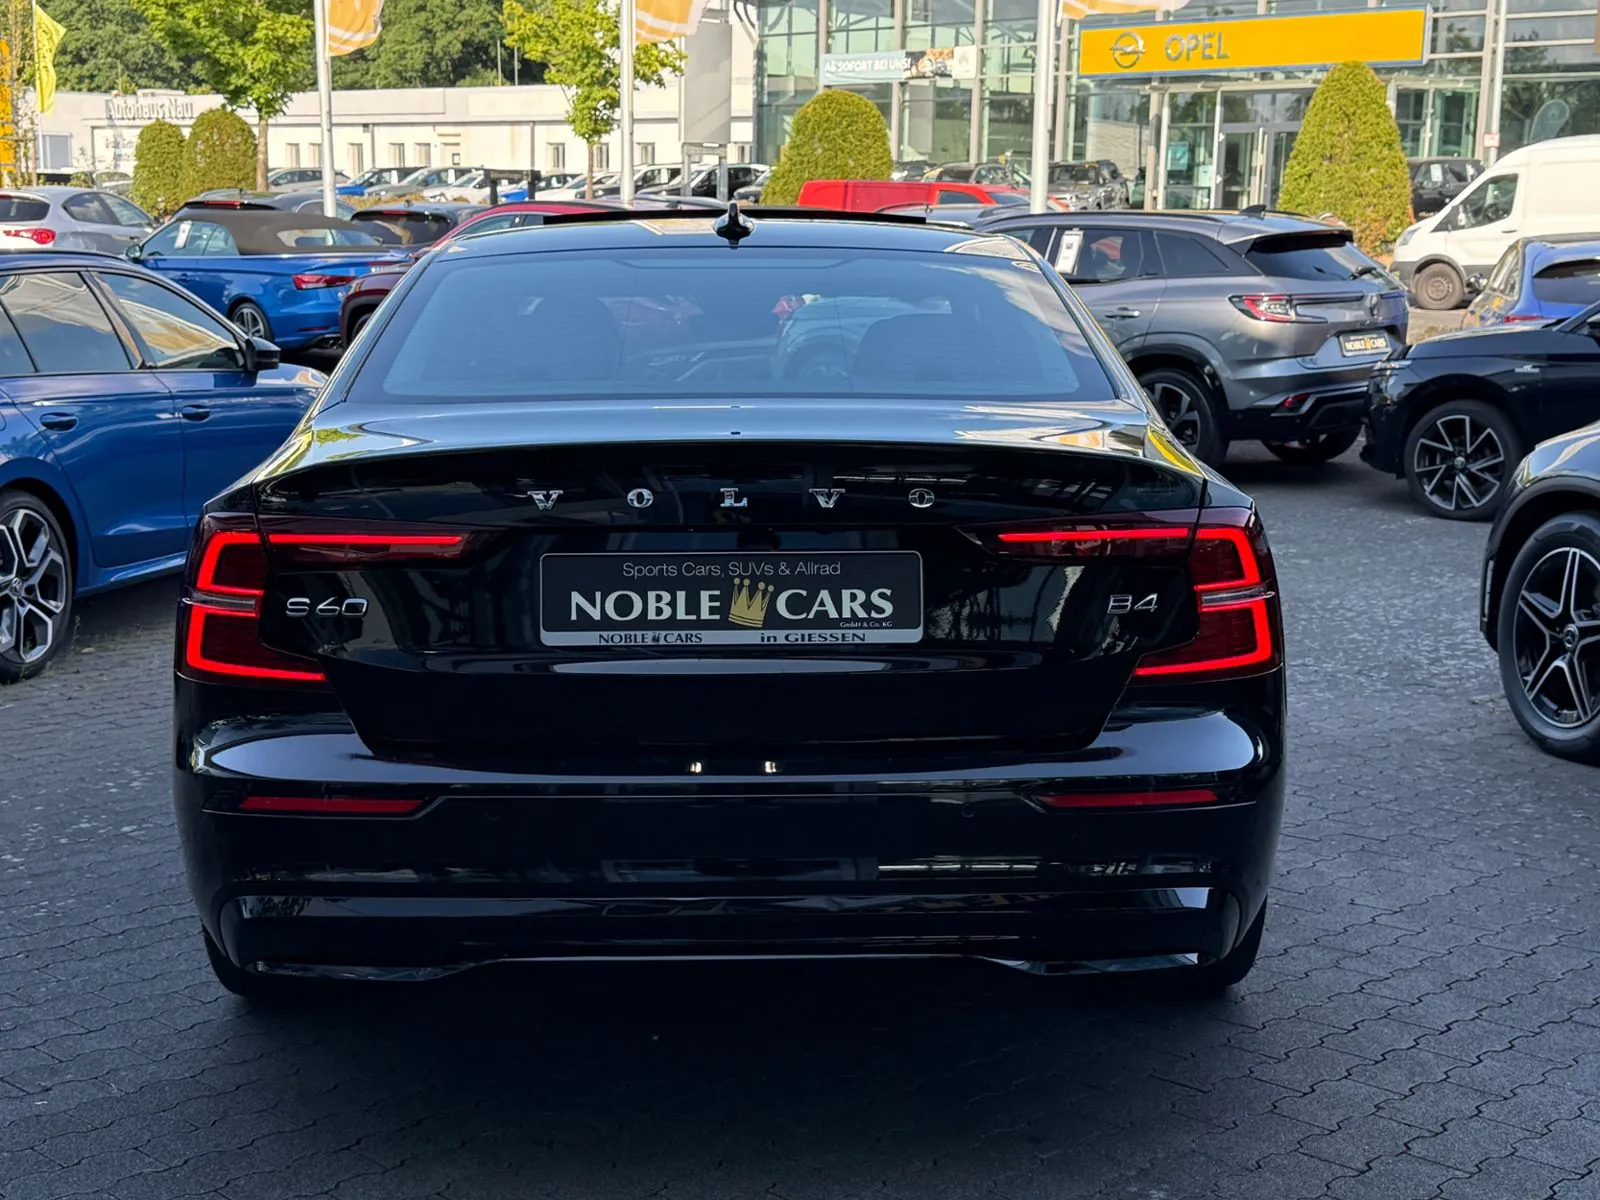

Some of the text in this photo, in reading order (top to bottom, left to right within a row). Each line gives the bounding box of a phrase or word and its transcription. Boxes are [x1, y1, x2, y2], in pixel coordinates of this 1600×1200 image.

[1165, 32, 1229, 62] OPEL
[527, 488, 935, 512] VOLVO
[622, 560, 841, 579] Sports Cars, SUVs & Allrad
[285, 597, 368, 616] S60
[570, 587, 894, 621] NOBLE CARS
[1107, 593, 1158, 614] B4
[598, 632, 703, 645] NOBLE CARS
[760, 632, 866, 643] in GIESSEN
